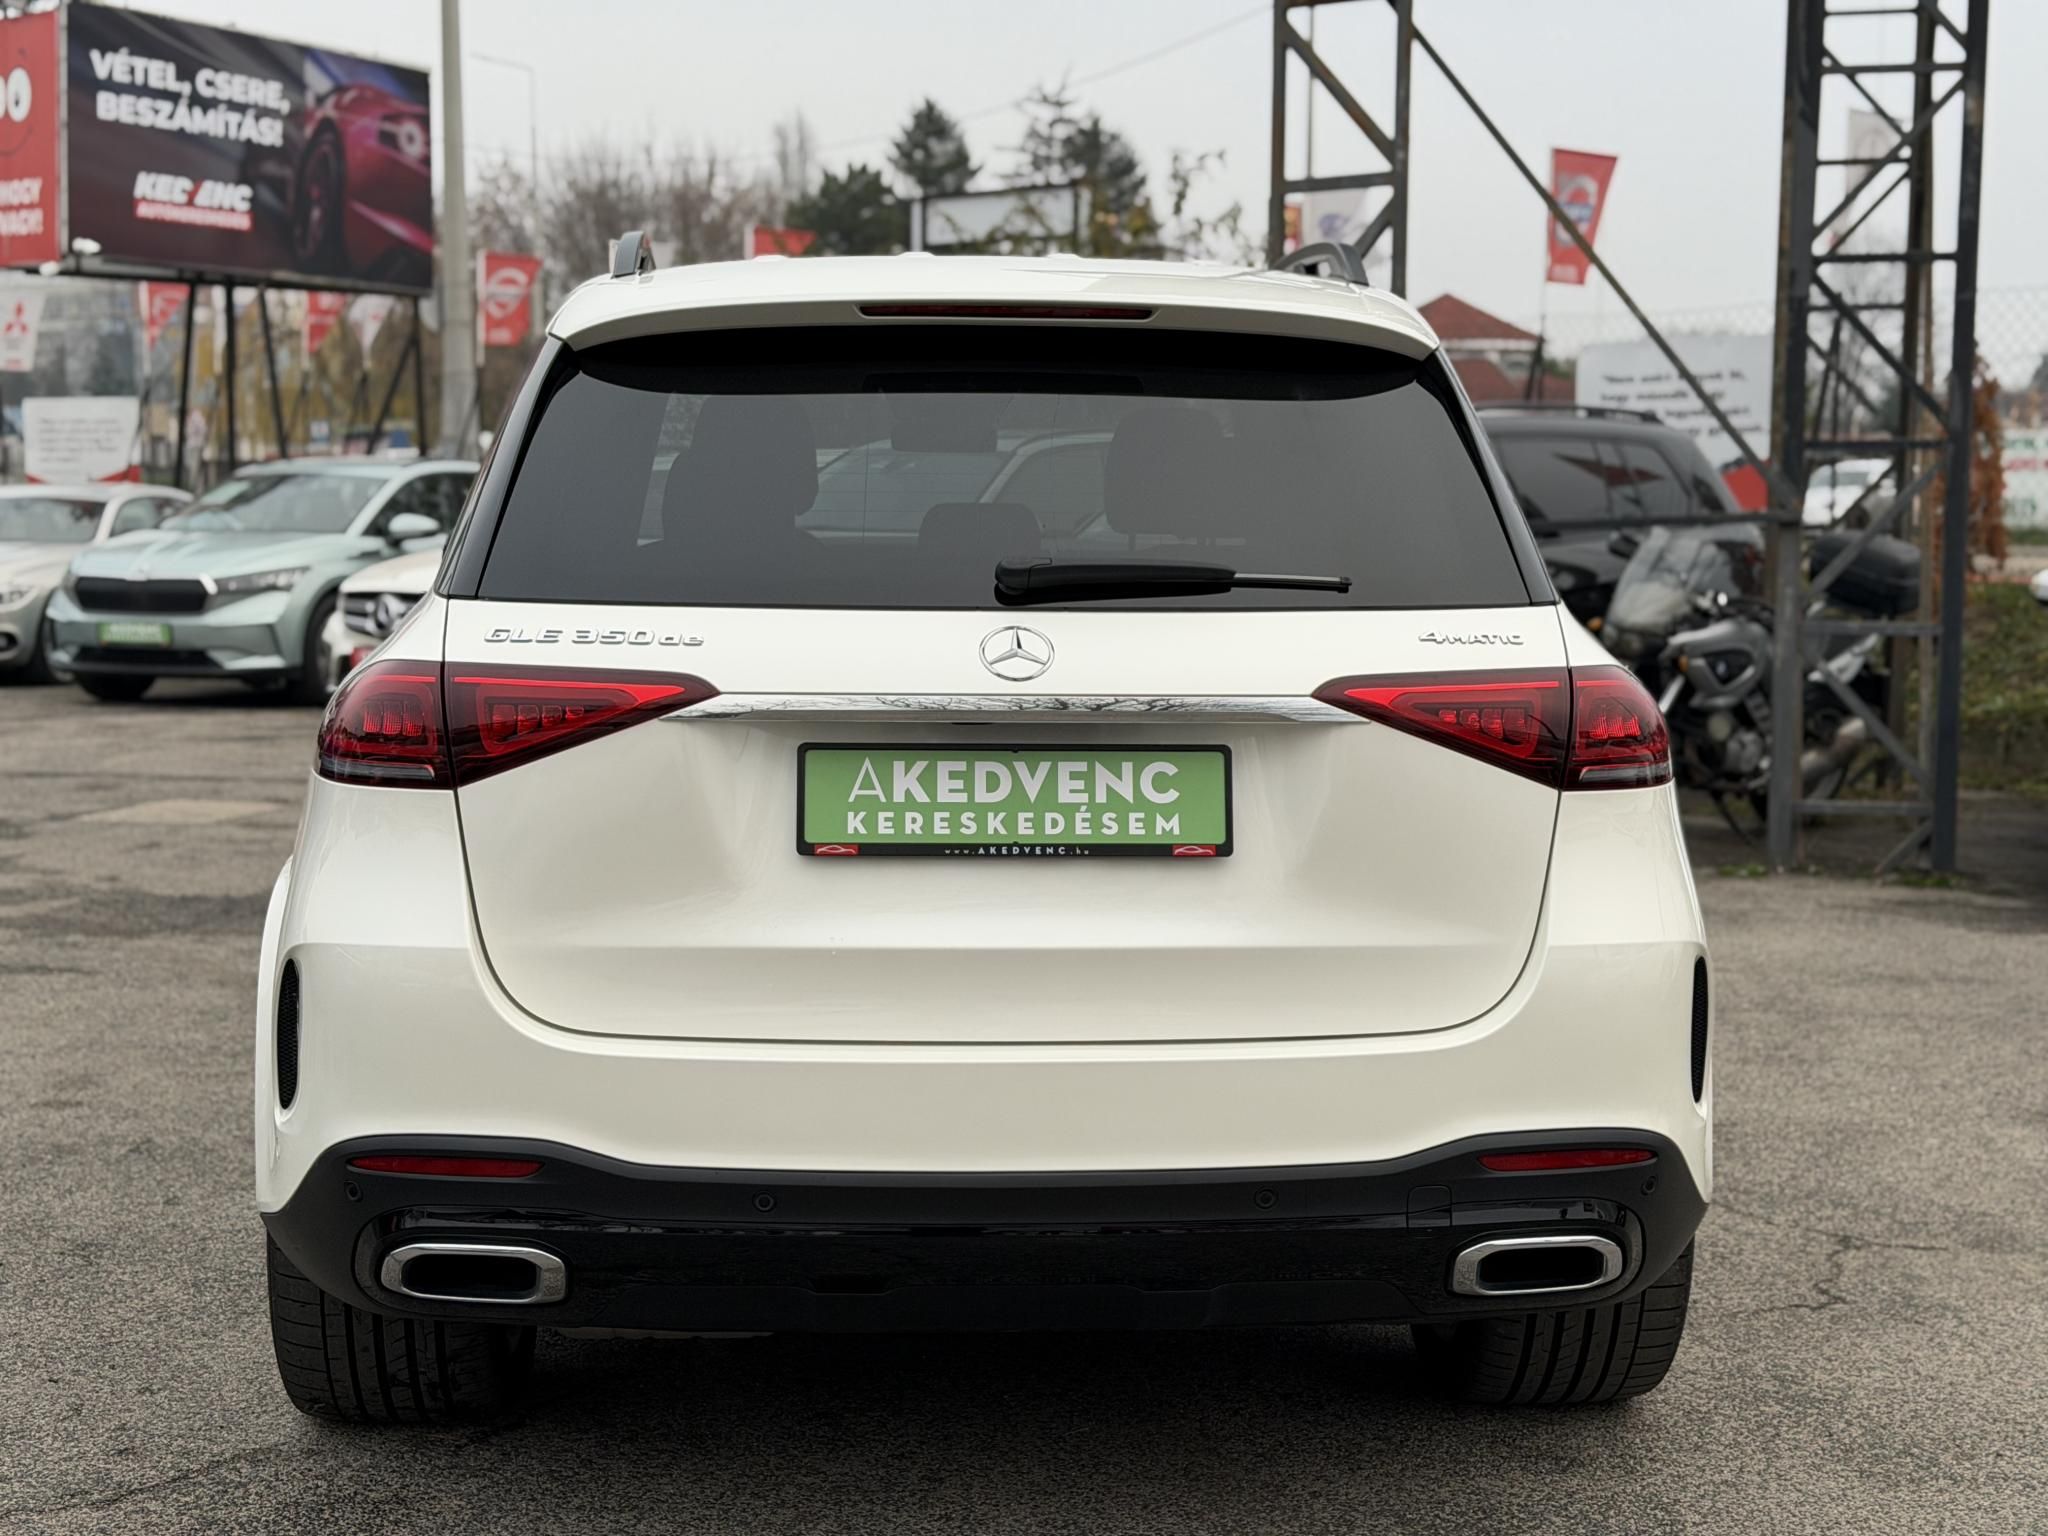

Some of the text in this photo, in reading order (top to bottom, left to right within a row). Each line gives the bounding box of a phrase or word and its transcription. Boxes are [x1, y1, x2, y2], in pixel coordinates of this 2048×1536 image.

[89, 47, 291, 116] VÉTEL, CSERE,
[96, 90, 284, 148] BESZÁMÍTÁS!
[483, 626, 564, 644] GLE
[1418, 630, 1525, 646] 4MATIC
[847, 806, 1180, 836] KERESKEDÉSEM
[945, 846, 1090, 855] www.AKEDVENC.hu
